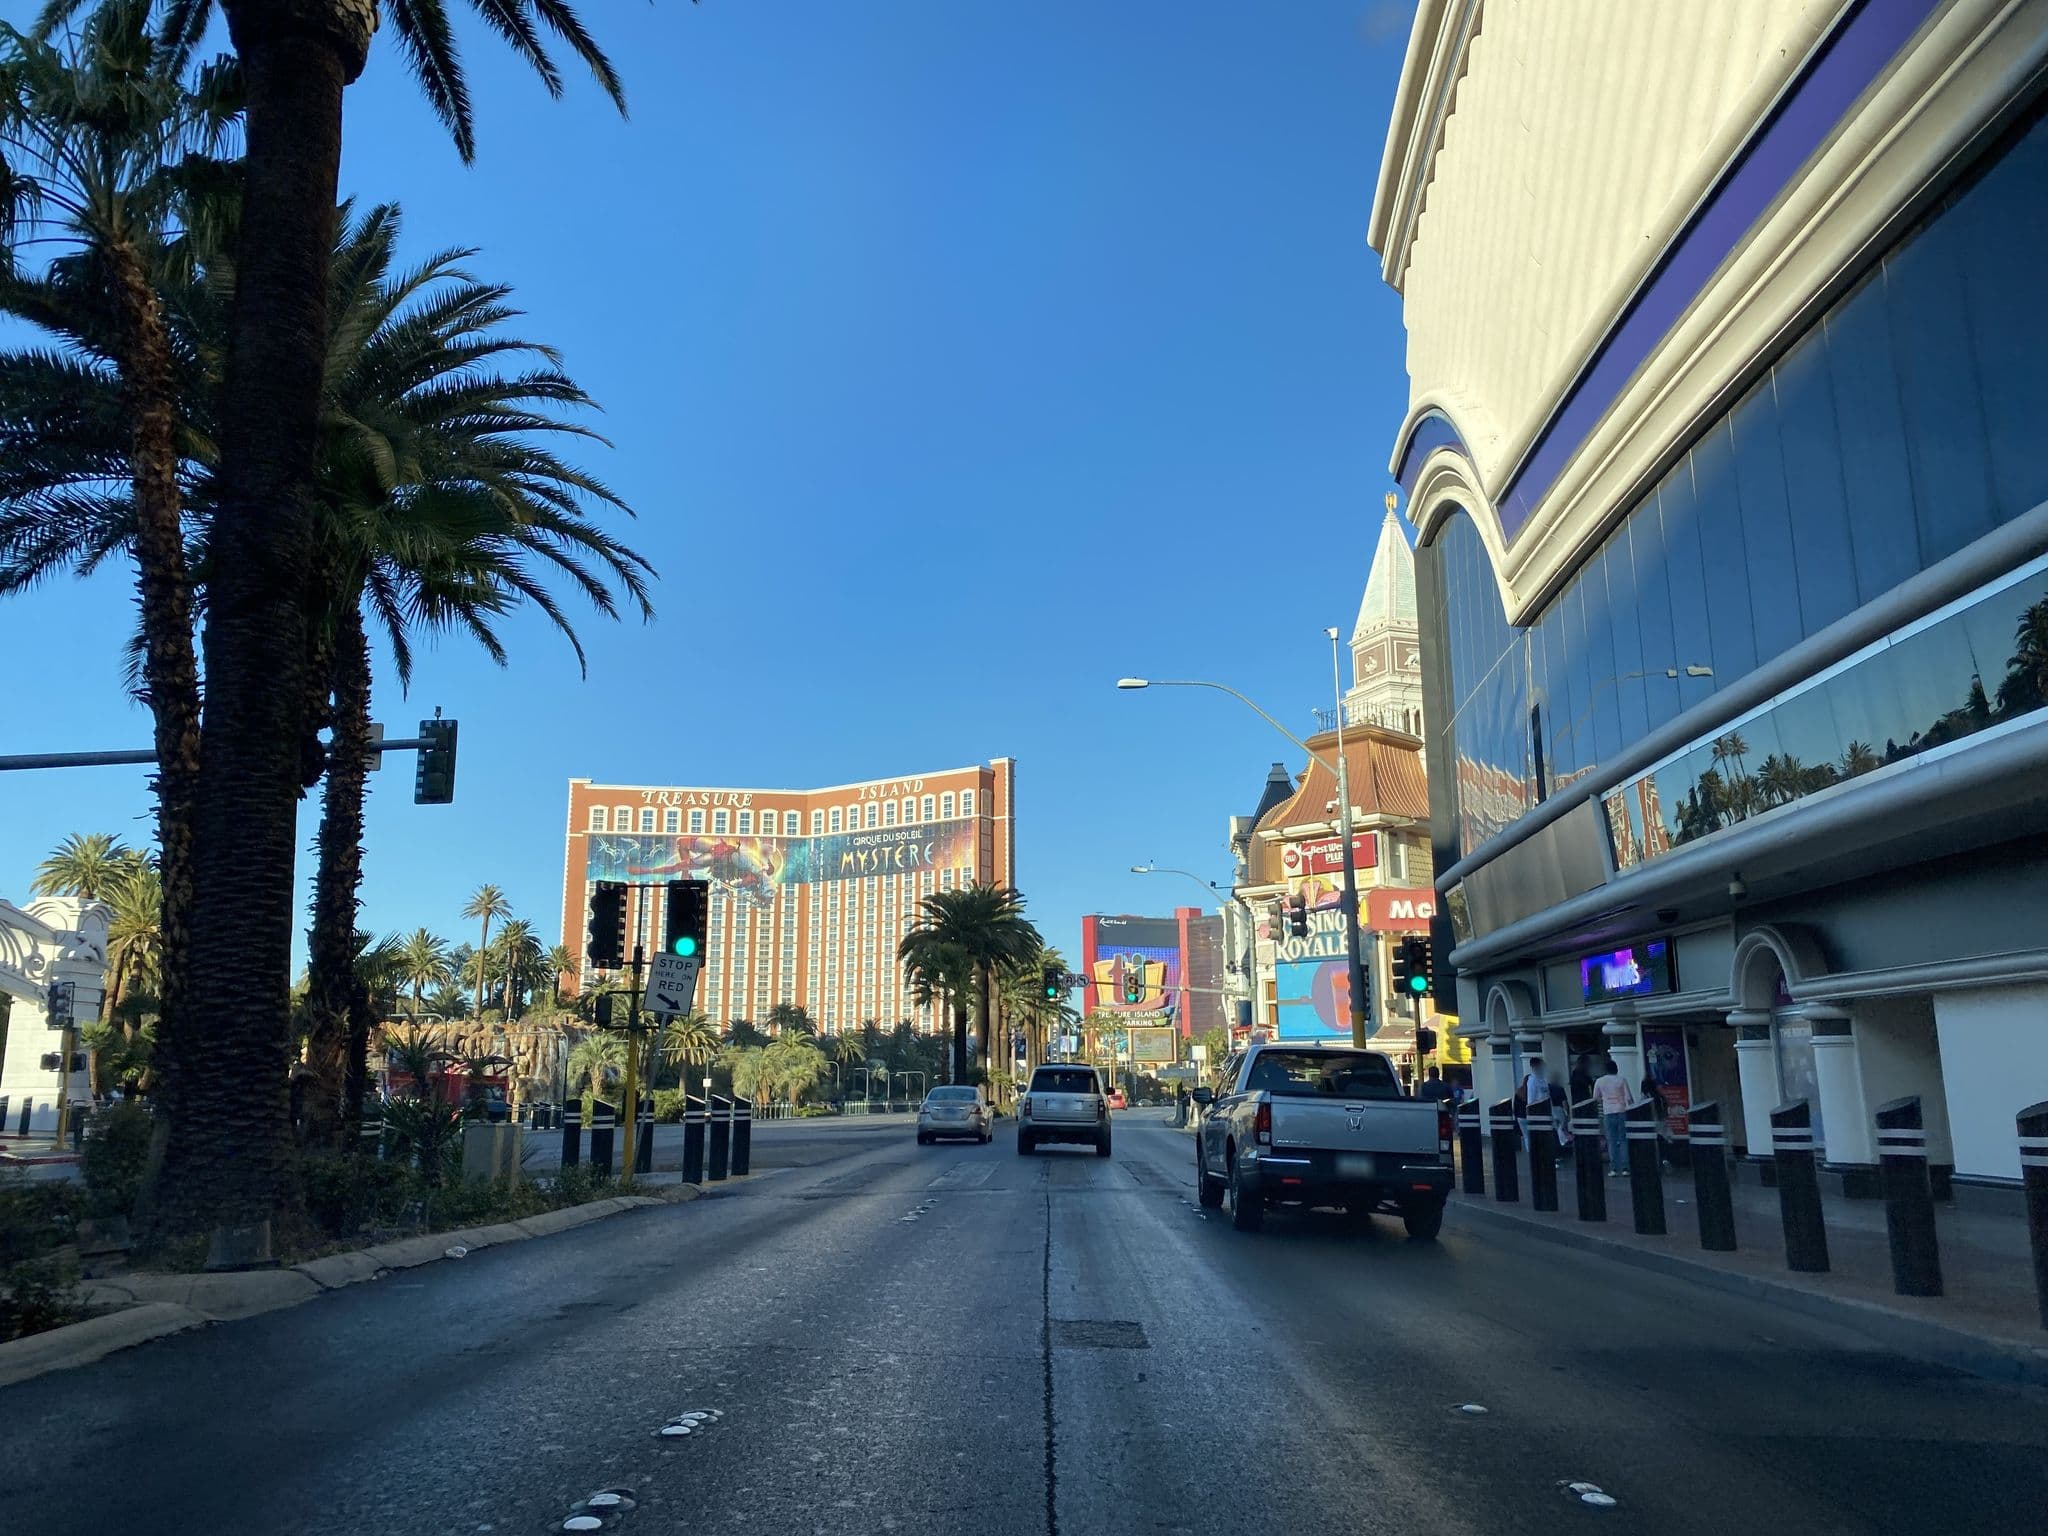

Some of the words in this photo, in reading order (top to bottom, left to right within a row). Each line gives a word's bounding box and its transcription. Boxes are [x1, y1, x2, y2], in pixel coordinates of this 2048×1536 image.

[858, 780, 924, 800] ISLAND
[641, 790, 753, 807] TREASURE
[853, 834, 881, 846] CIRQUE
[883, 833, 894, 841] DU
[896, 831, 922, 840] SOLEIL
[1311, 845, 1327, 853] Best
[1328, 840, 1361, 852] Wern
[841, 841, 934, 873] MYSTÈRE
[1275, 934, 1349, 962] ROYALE
[659, 959, 693, 971] STOP
[658, 981, 684, 992] RED
[1098, 1011, 1130, 1019] TREURE
